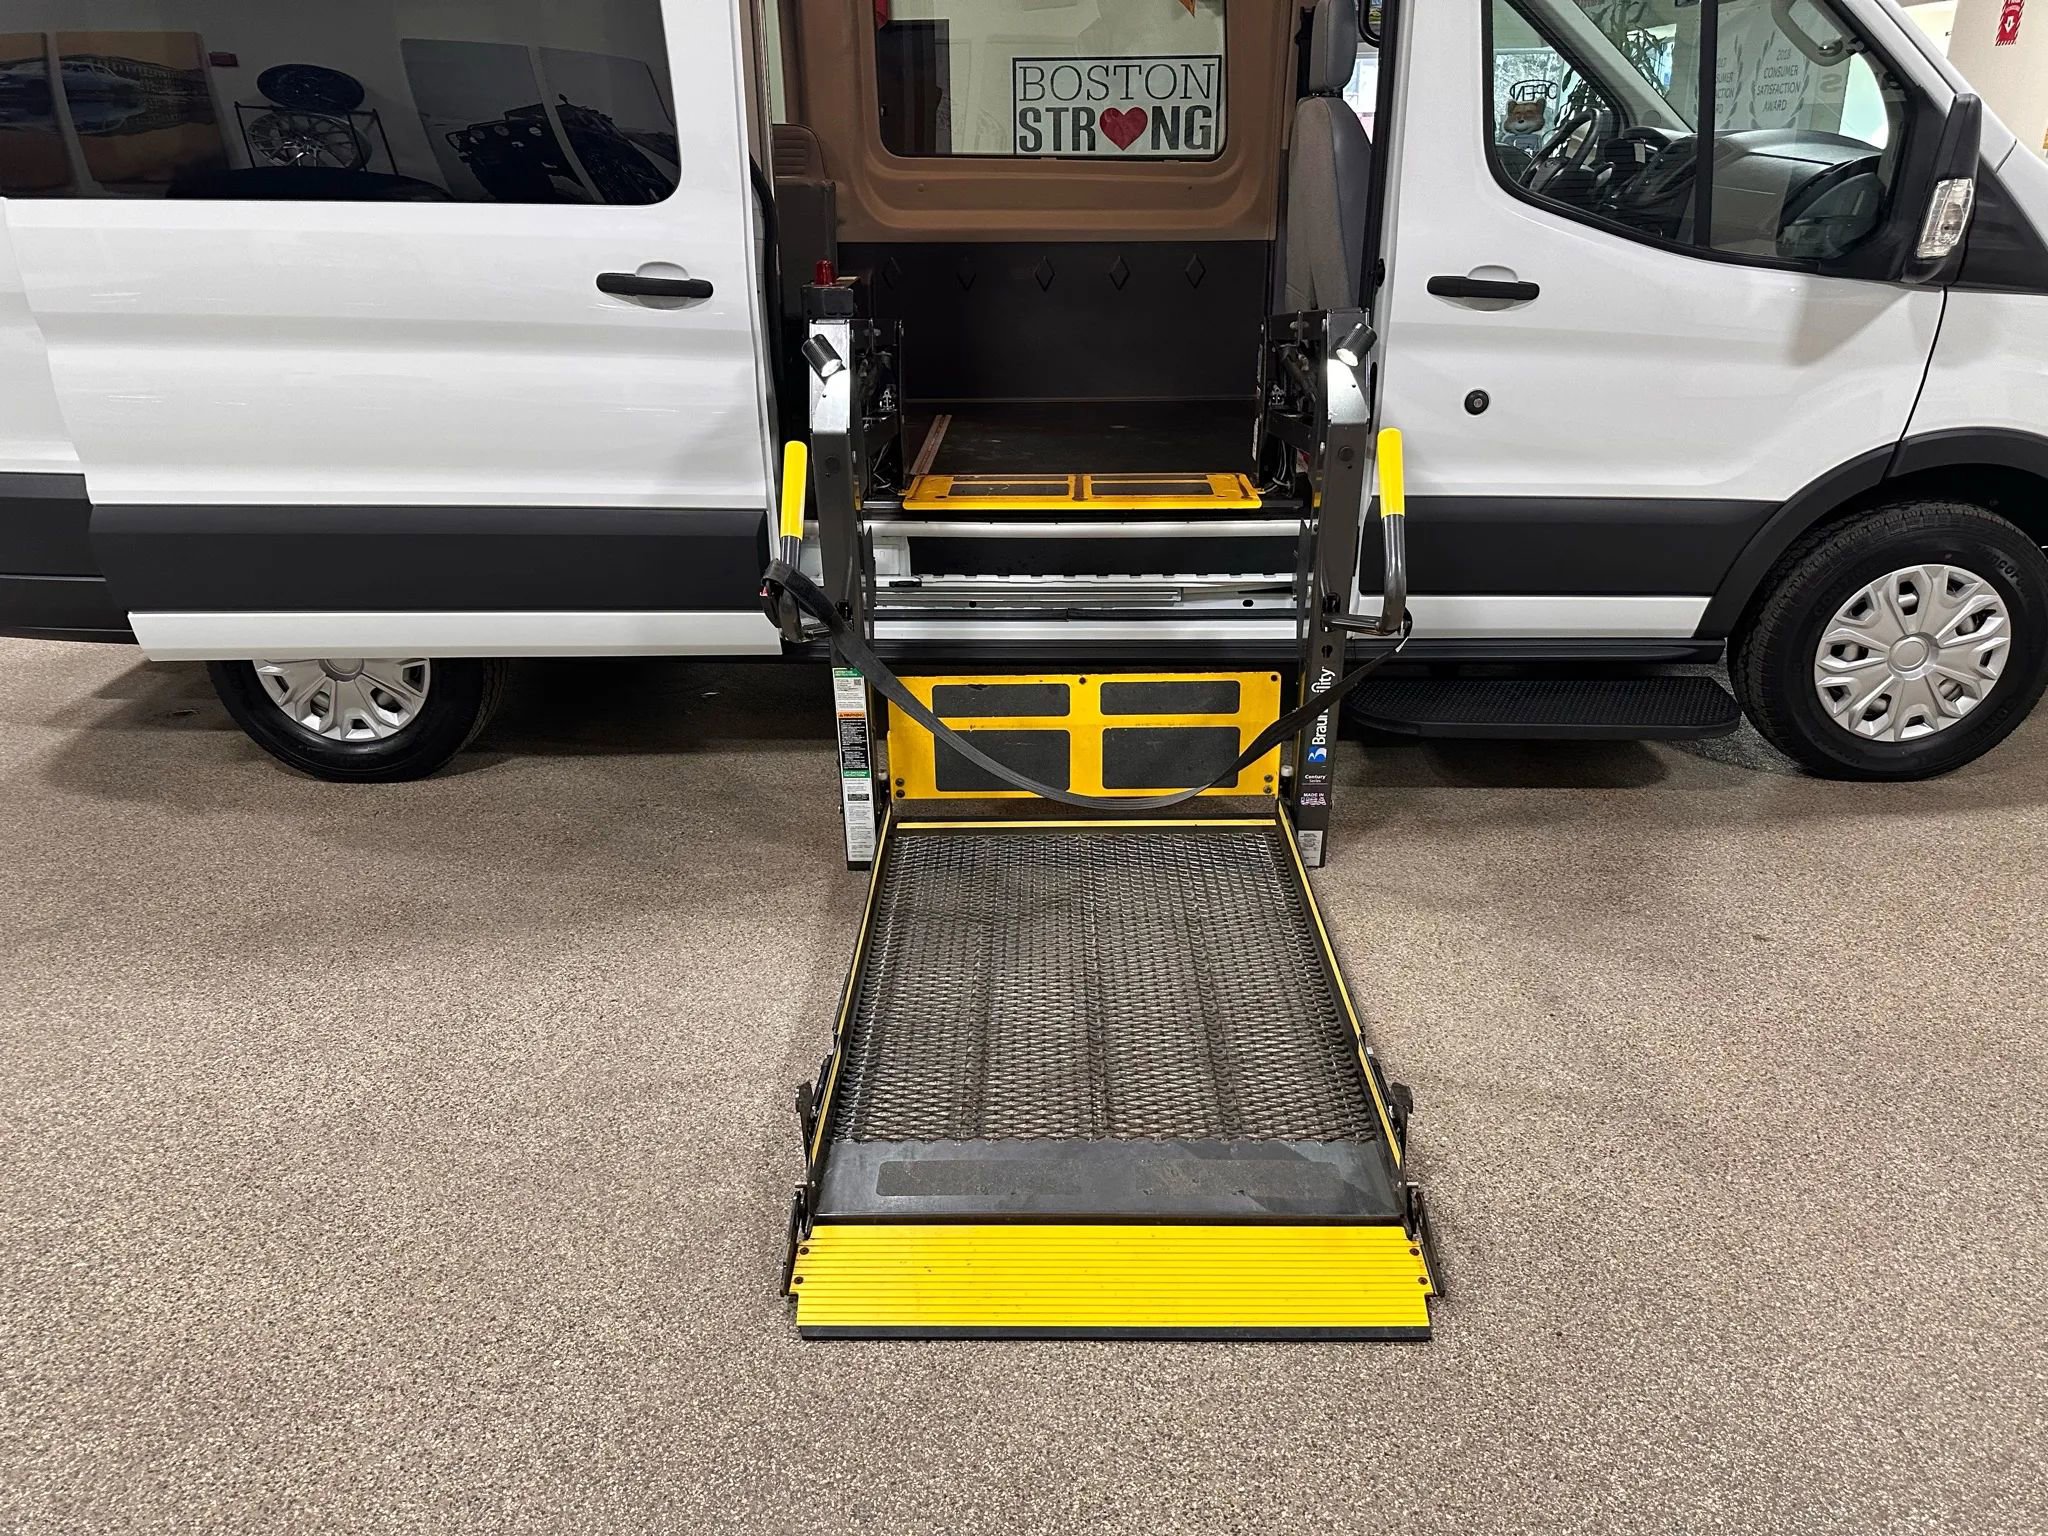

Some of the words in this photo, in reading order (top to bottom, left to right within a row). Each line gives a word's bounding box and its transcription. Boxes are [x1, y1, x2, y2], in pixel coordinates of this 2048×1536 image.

[1716, 72, 1734, 83] SUMER
[1763, 65, 1799, 79] CONSUMER
[1018, 64, 1216, 101] BOSTON
[1756, 82, 1801, 96] SATISFACTION
[1762, 100, 1787, 112] AWARD
